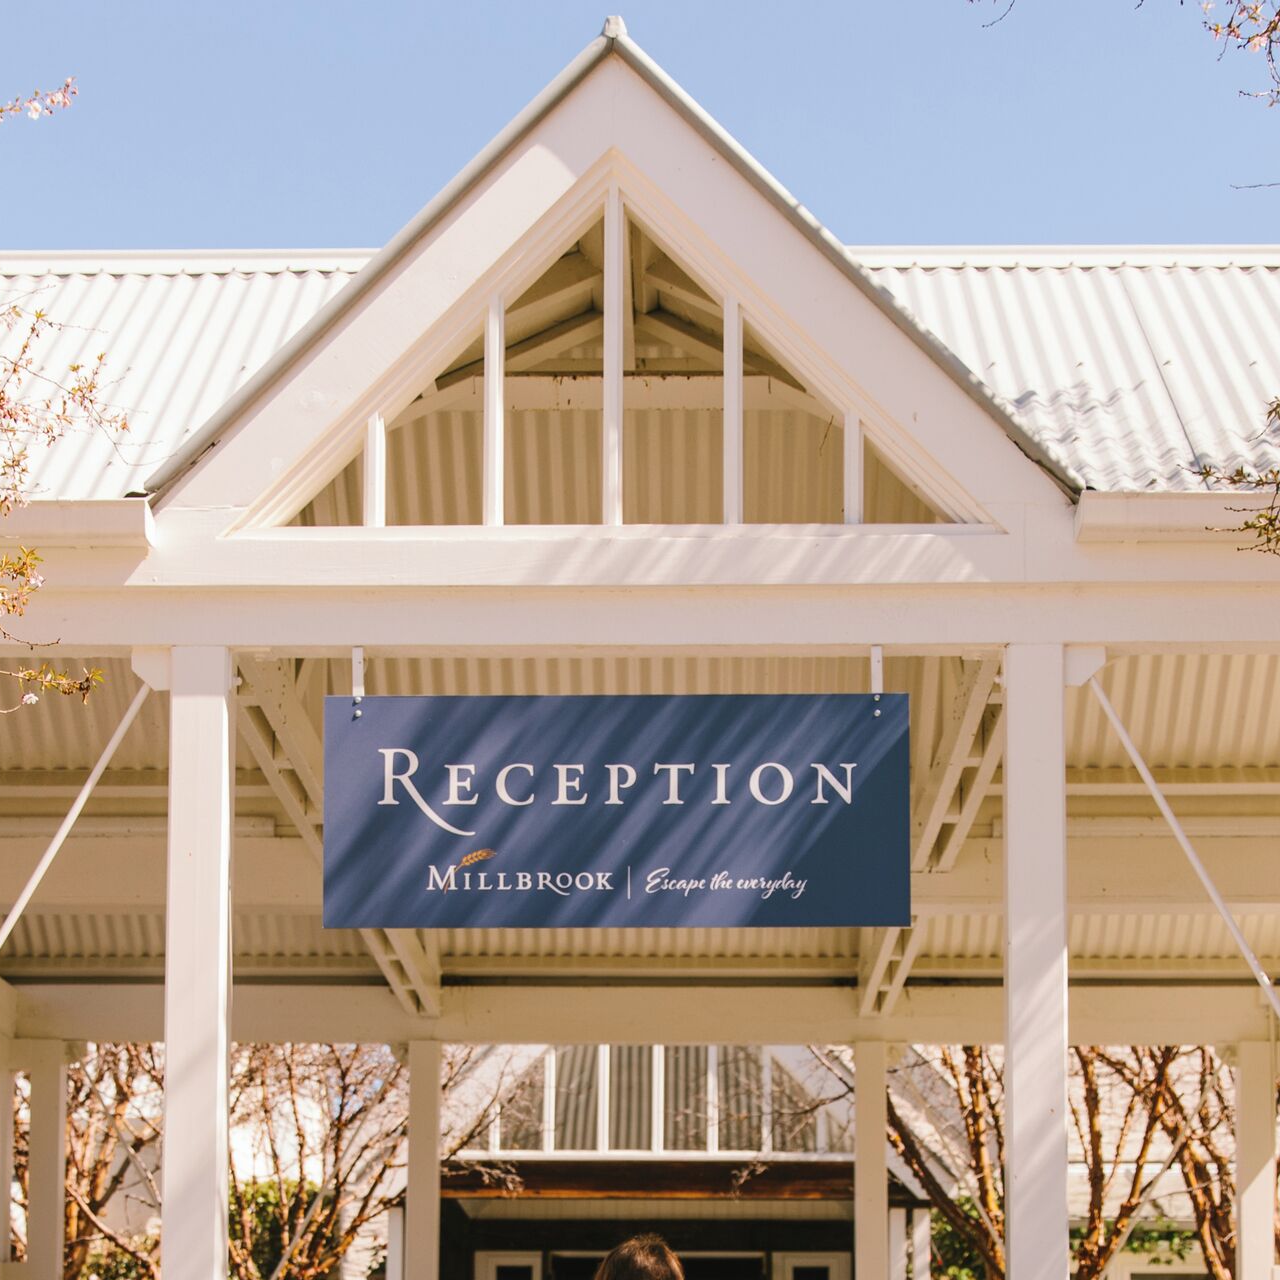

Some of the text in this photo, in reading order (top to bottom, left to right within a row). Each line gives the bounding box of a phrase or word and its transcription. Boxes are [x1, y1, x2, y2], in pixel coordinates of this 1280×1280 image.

[376, 748, 858, 836] RECEPTION
[426, 865, 614, 896] MILLBROOK
[645, 867, 808, 900] Escape the everyday
